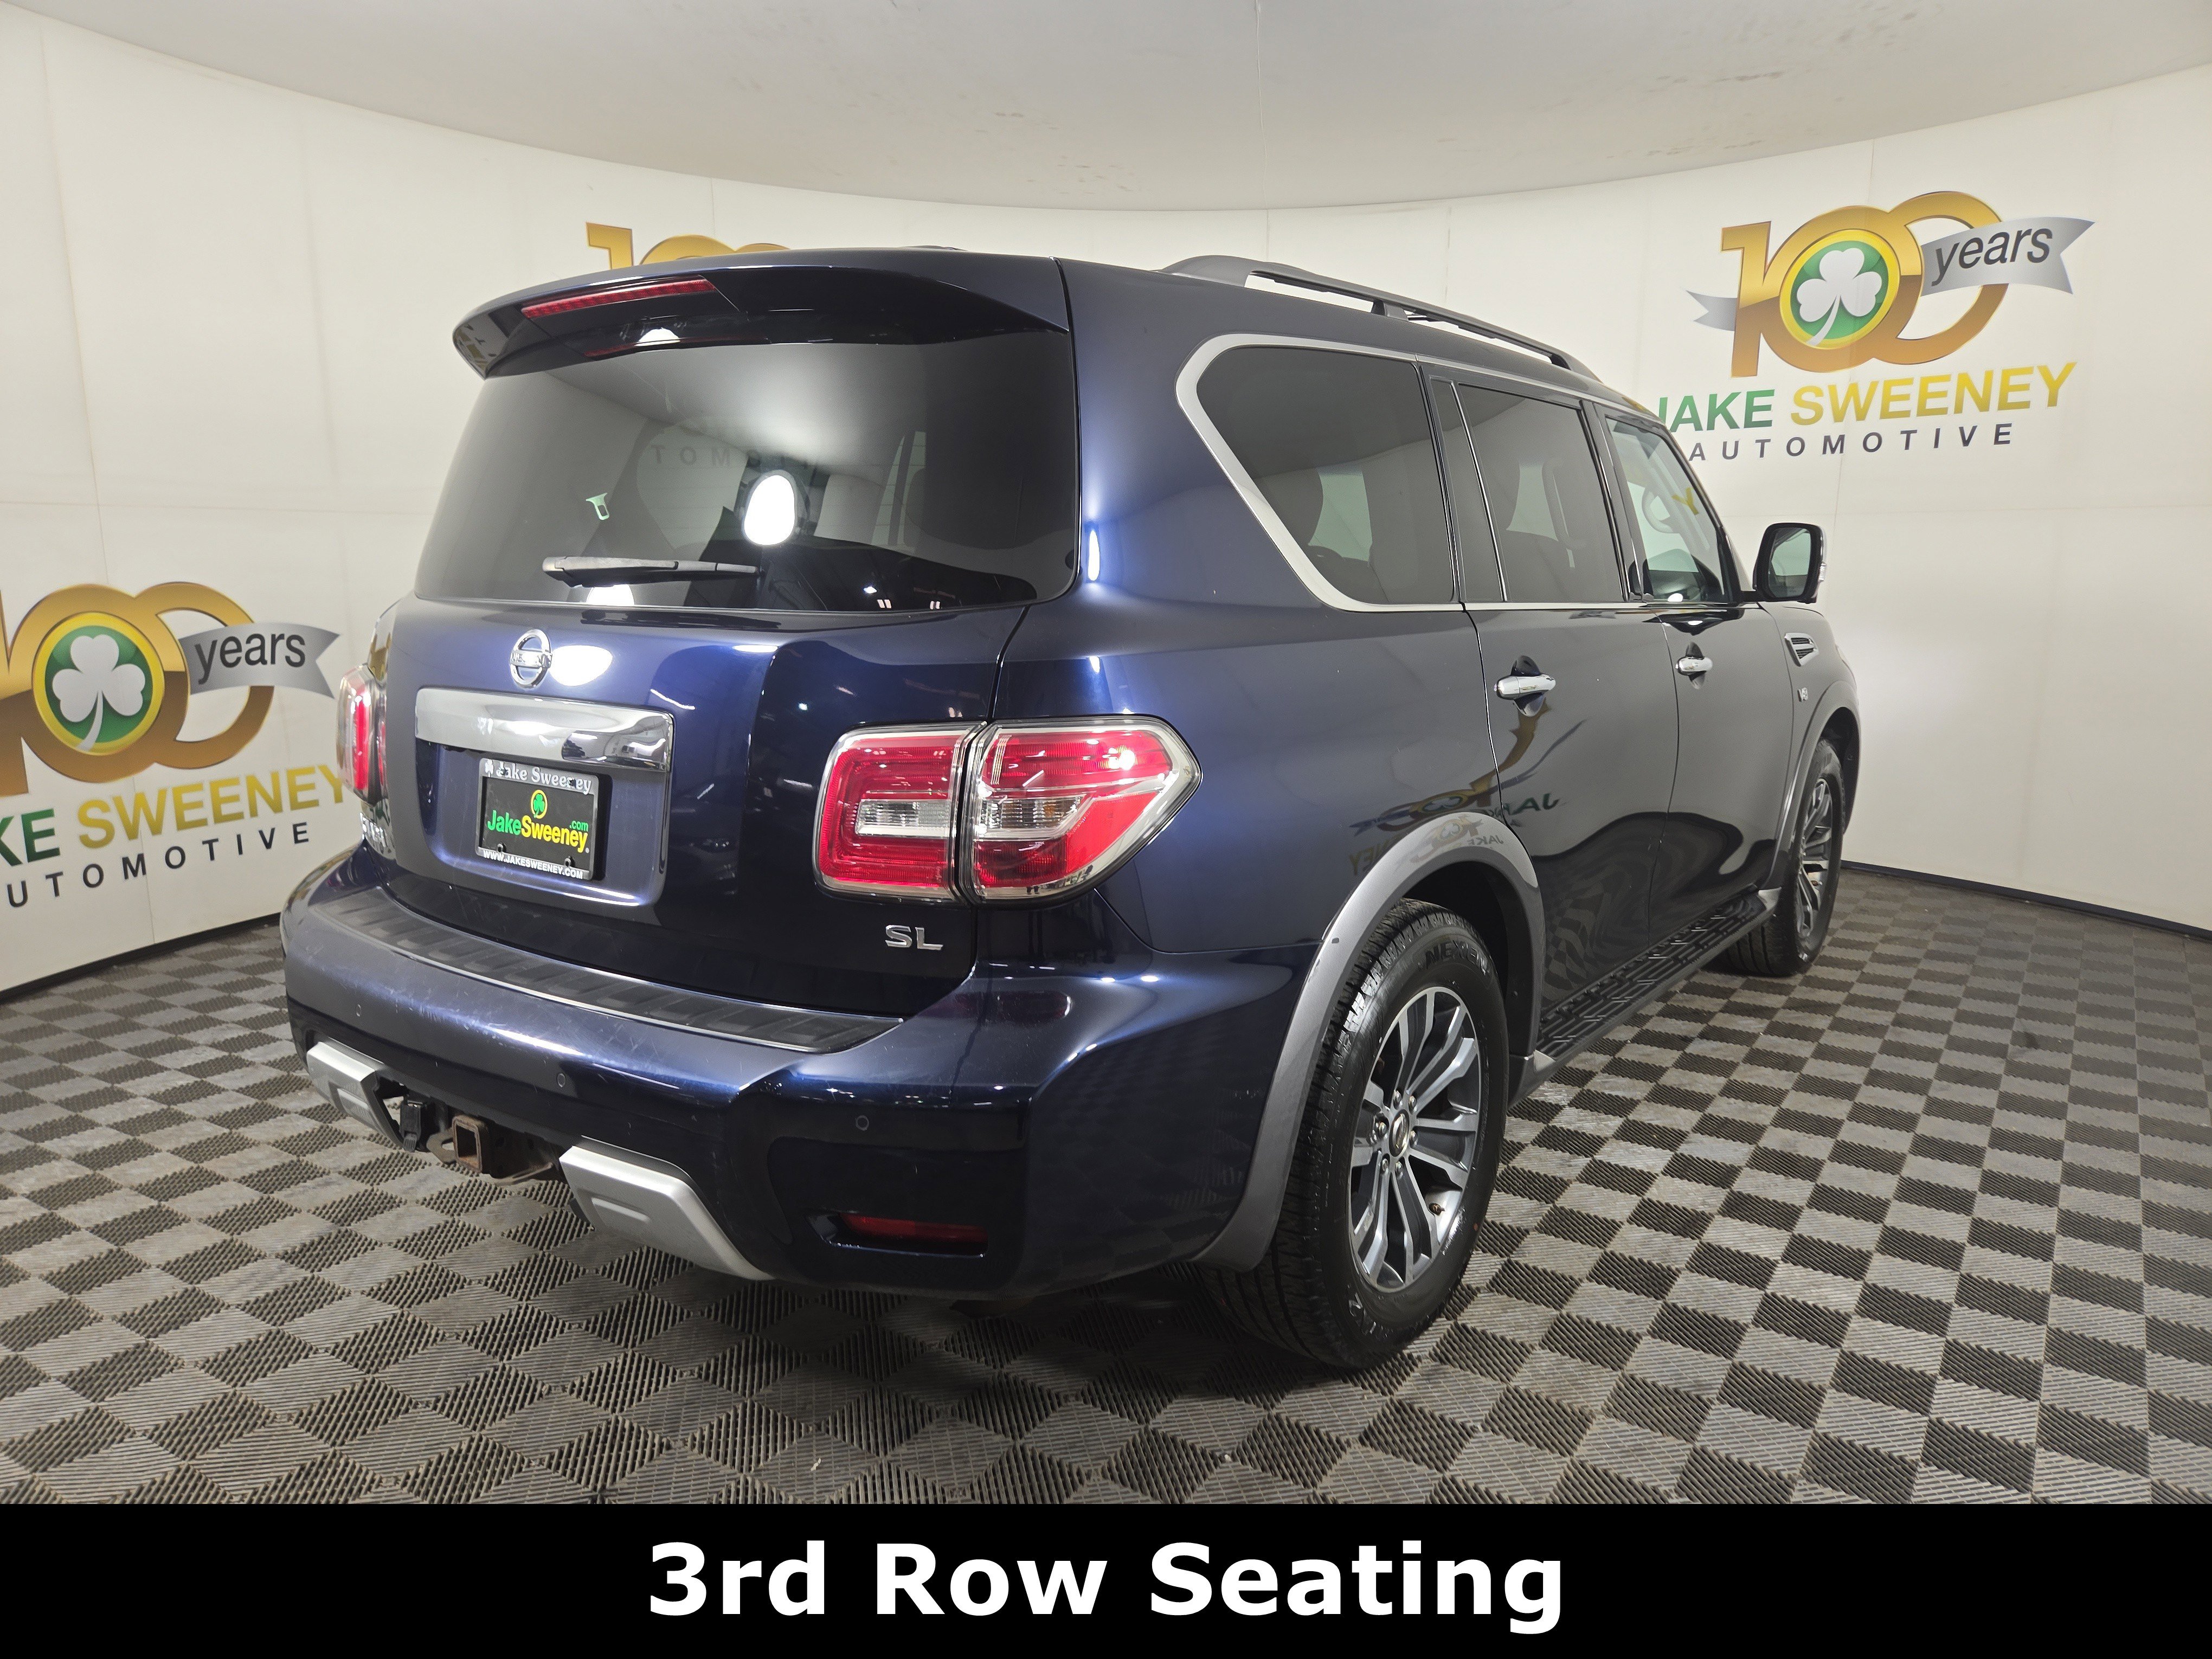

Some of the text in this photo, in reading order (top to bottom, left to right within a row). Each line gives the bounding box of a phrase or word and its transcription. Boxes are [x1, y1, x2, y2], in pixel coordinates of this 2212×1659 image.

[1931, 227, 2053, 287] years
[1790, 362, 2078, 426] SWEENEY
[1688, 423, 2013, 461] AUTOMOTIVE
[194, 632, 306, 685] years
[78, 763, 344, 849] SWEENEY
[483, 850, 583, 879] WWW.JAKESWEENEY.COM
[885, 924, 944, 950] SL
